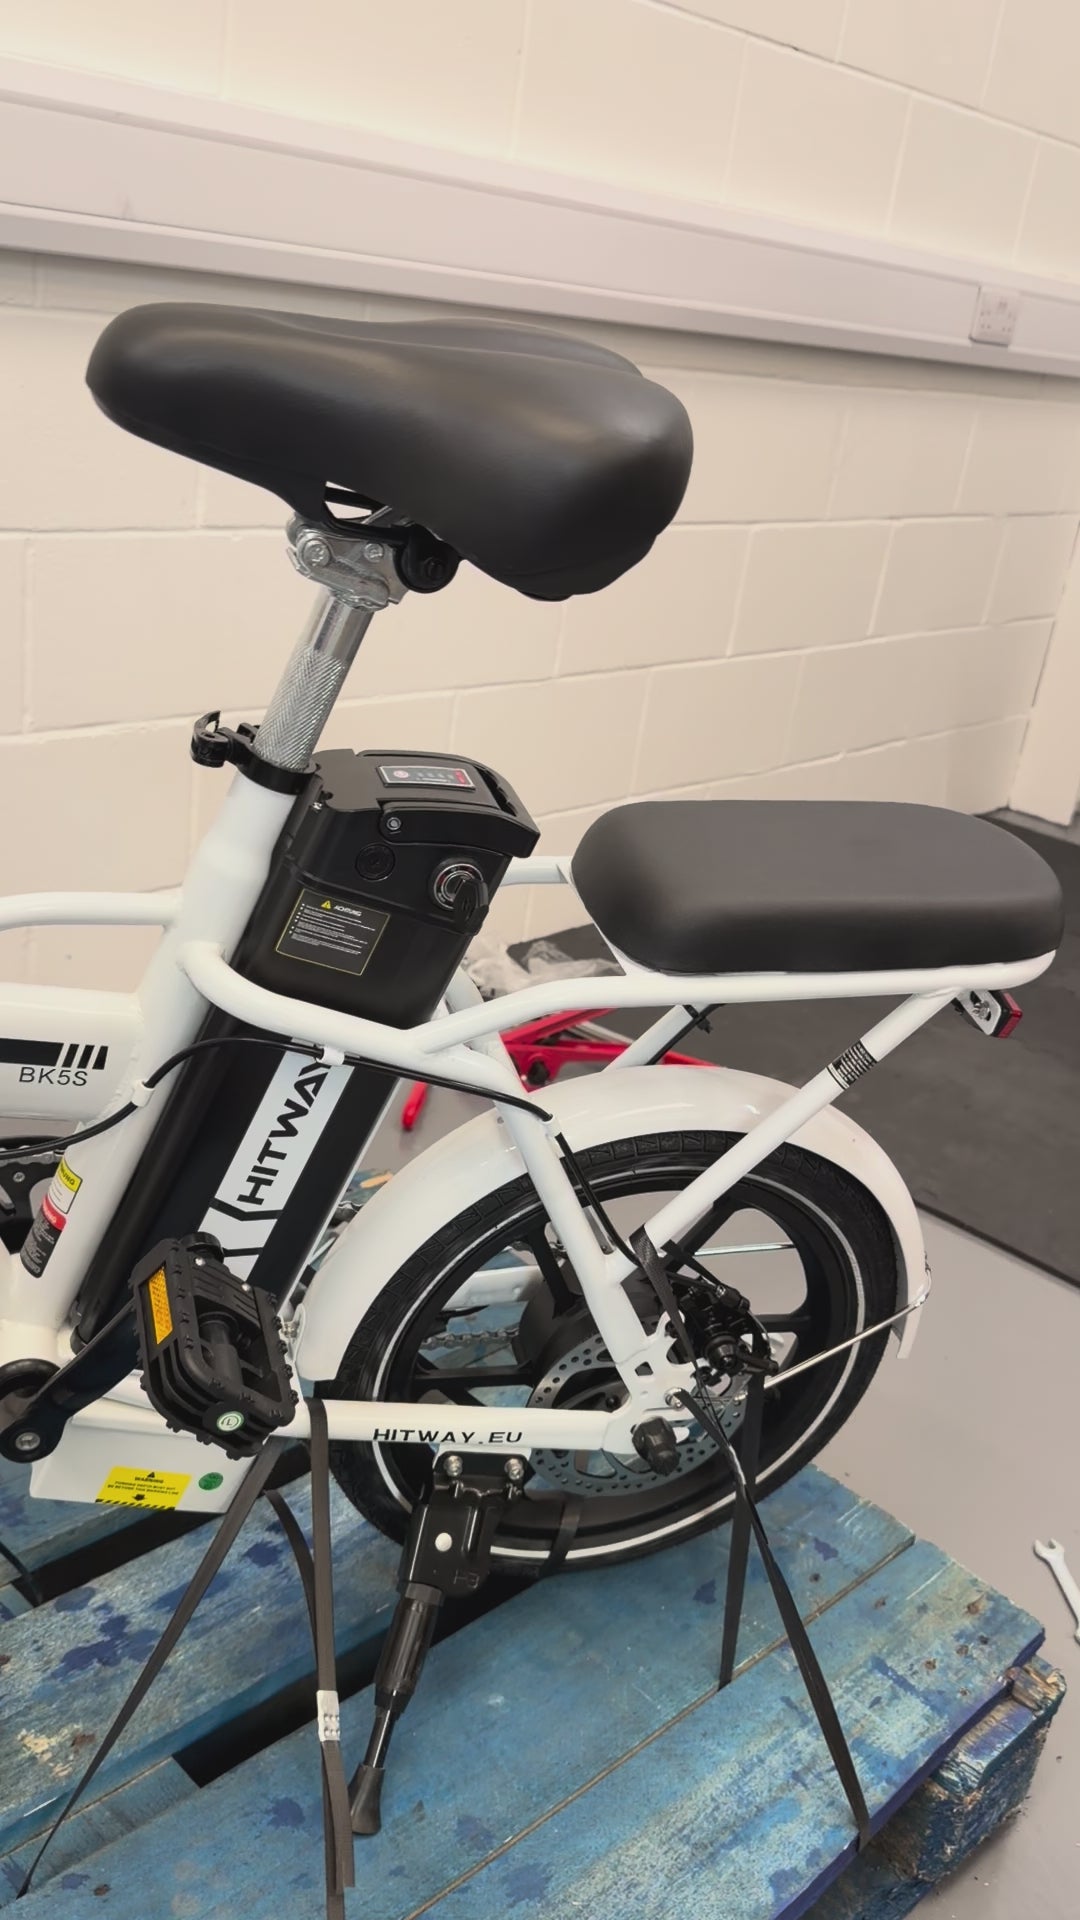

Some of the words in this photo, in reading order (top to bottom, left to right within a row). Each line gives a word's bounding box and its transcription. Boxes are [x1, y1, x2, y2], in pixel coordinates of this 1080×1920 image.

[19, 1066, 88, 1087] BK5S
[236, 1061, 332, 1206] HITWAY
[373, 1428, 523, 1445] HITWAY.EU
